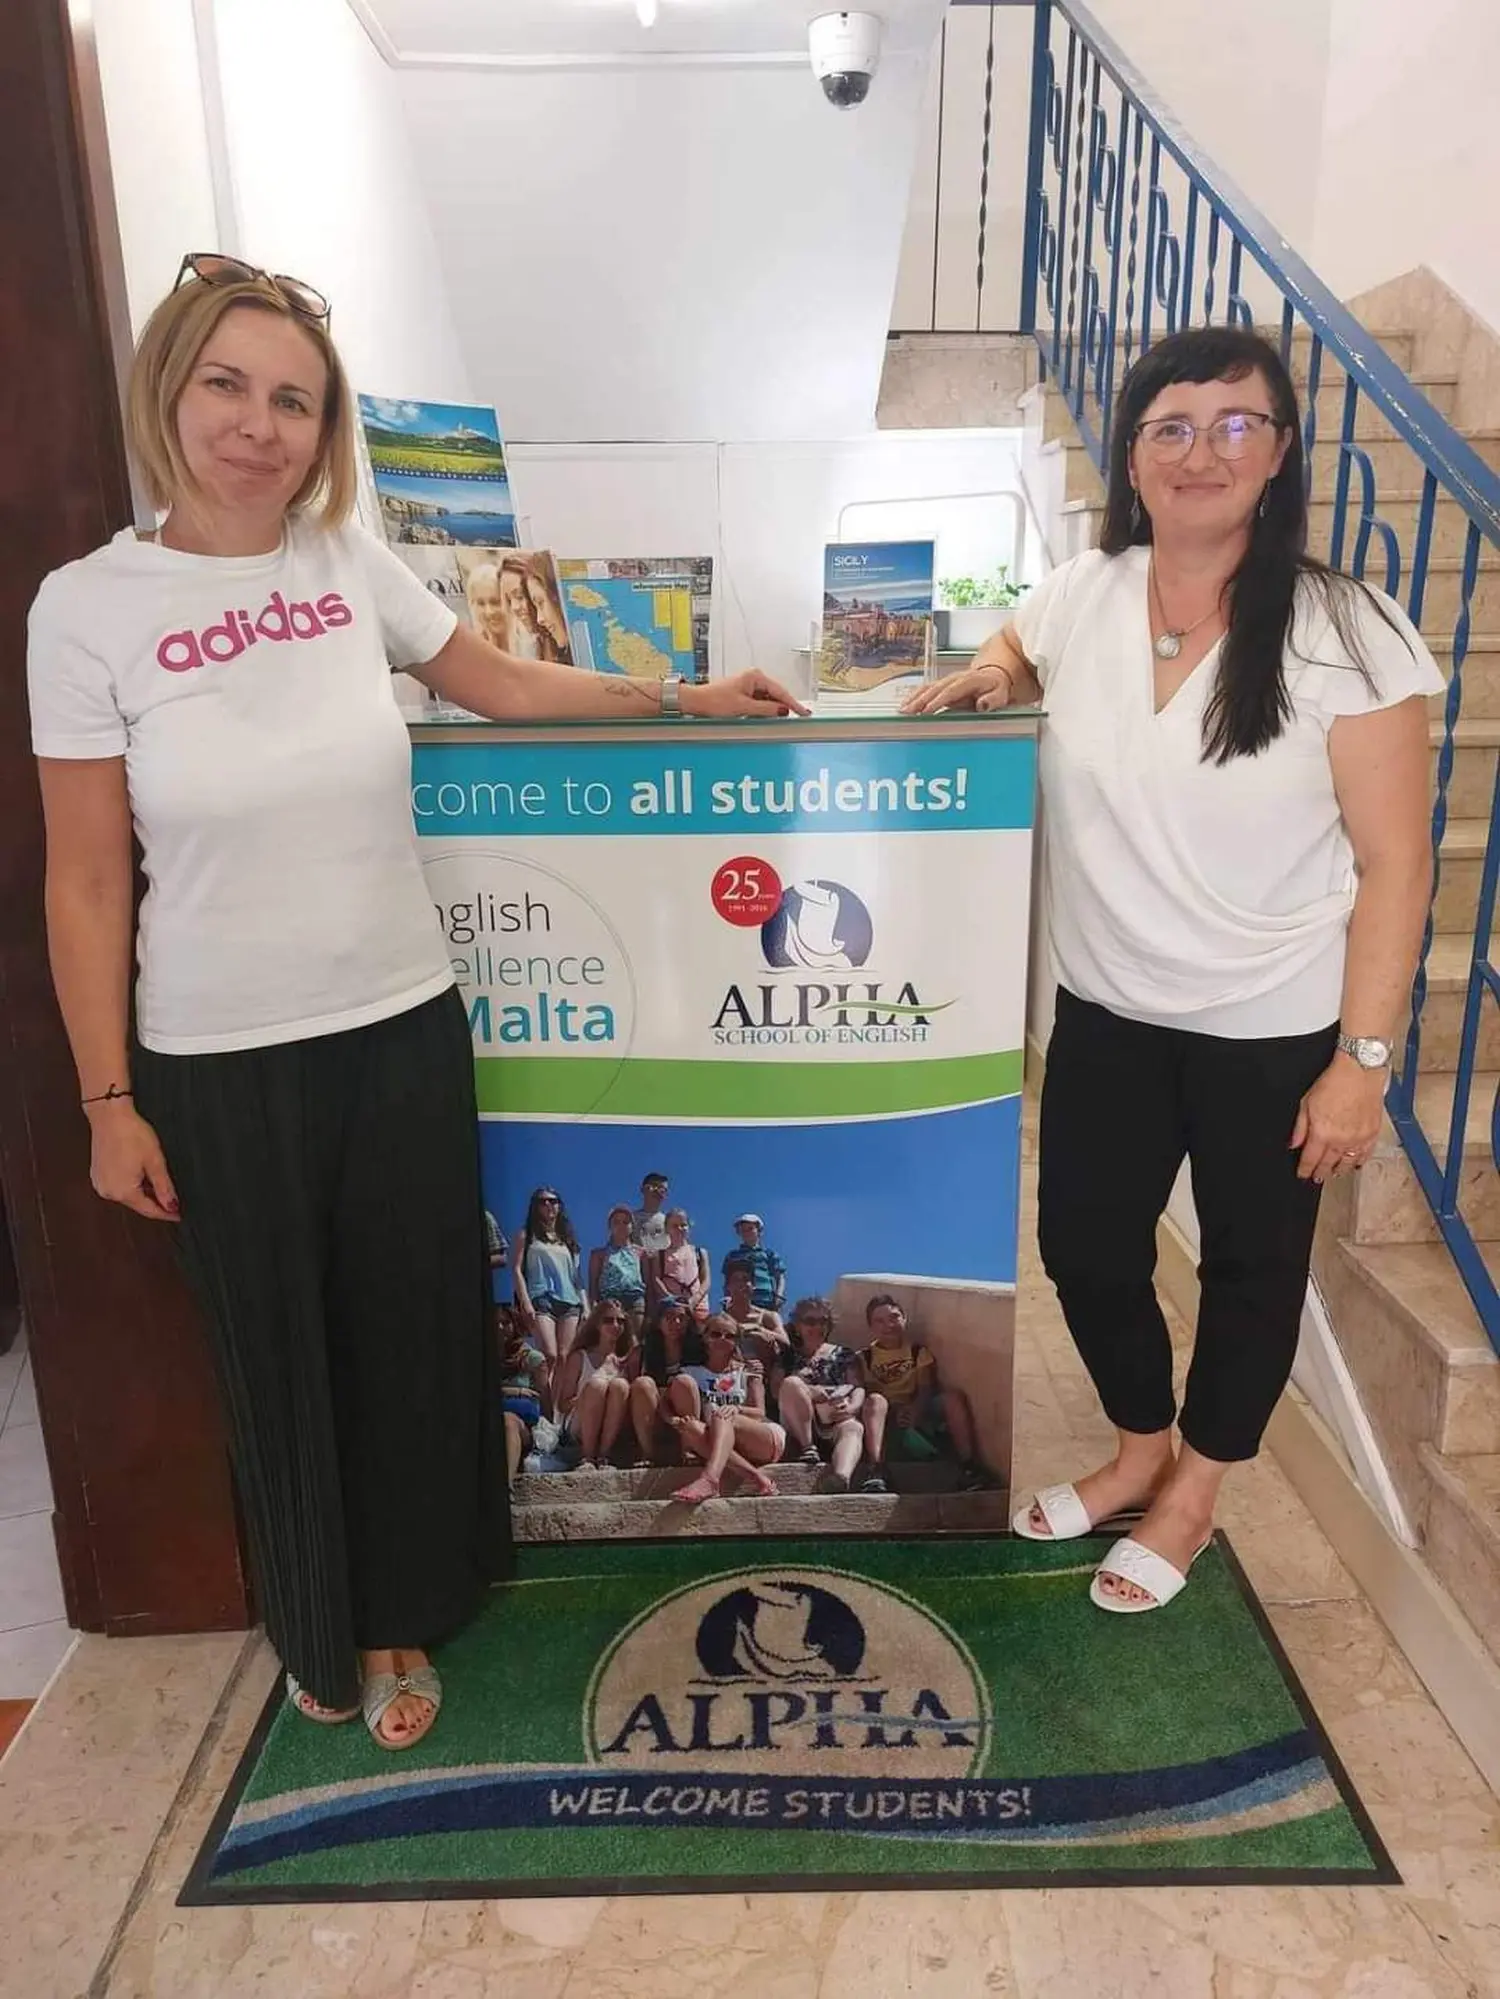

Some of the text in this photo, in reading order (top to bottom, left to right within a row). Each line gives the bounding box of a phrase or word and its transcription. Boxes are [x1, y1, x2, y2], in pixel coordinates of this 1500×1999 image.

[157, 591, 352, 673] adidas
[411, 768, 968, 817] come to all students!
[721, 868, 761, 900] 25
[450, 947, 605, 986] ellence
[710, 981, 931, 1029] ALPHA
[714, 1028, 928, 1045] SCHOOL OF ENGLISH
[601, 1689, 976, 1753] ALPHA
[549, 1786, 1033, 1820] WELCOME STUDENTS!
